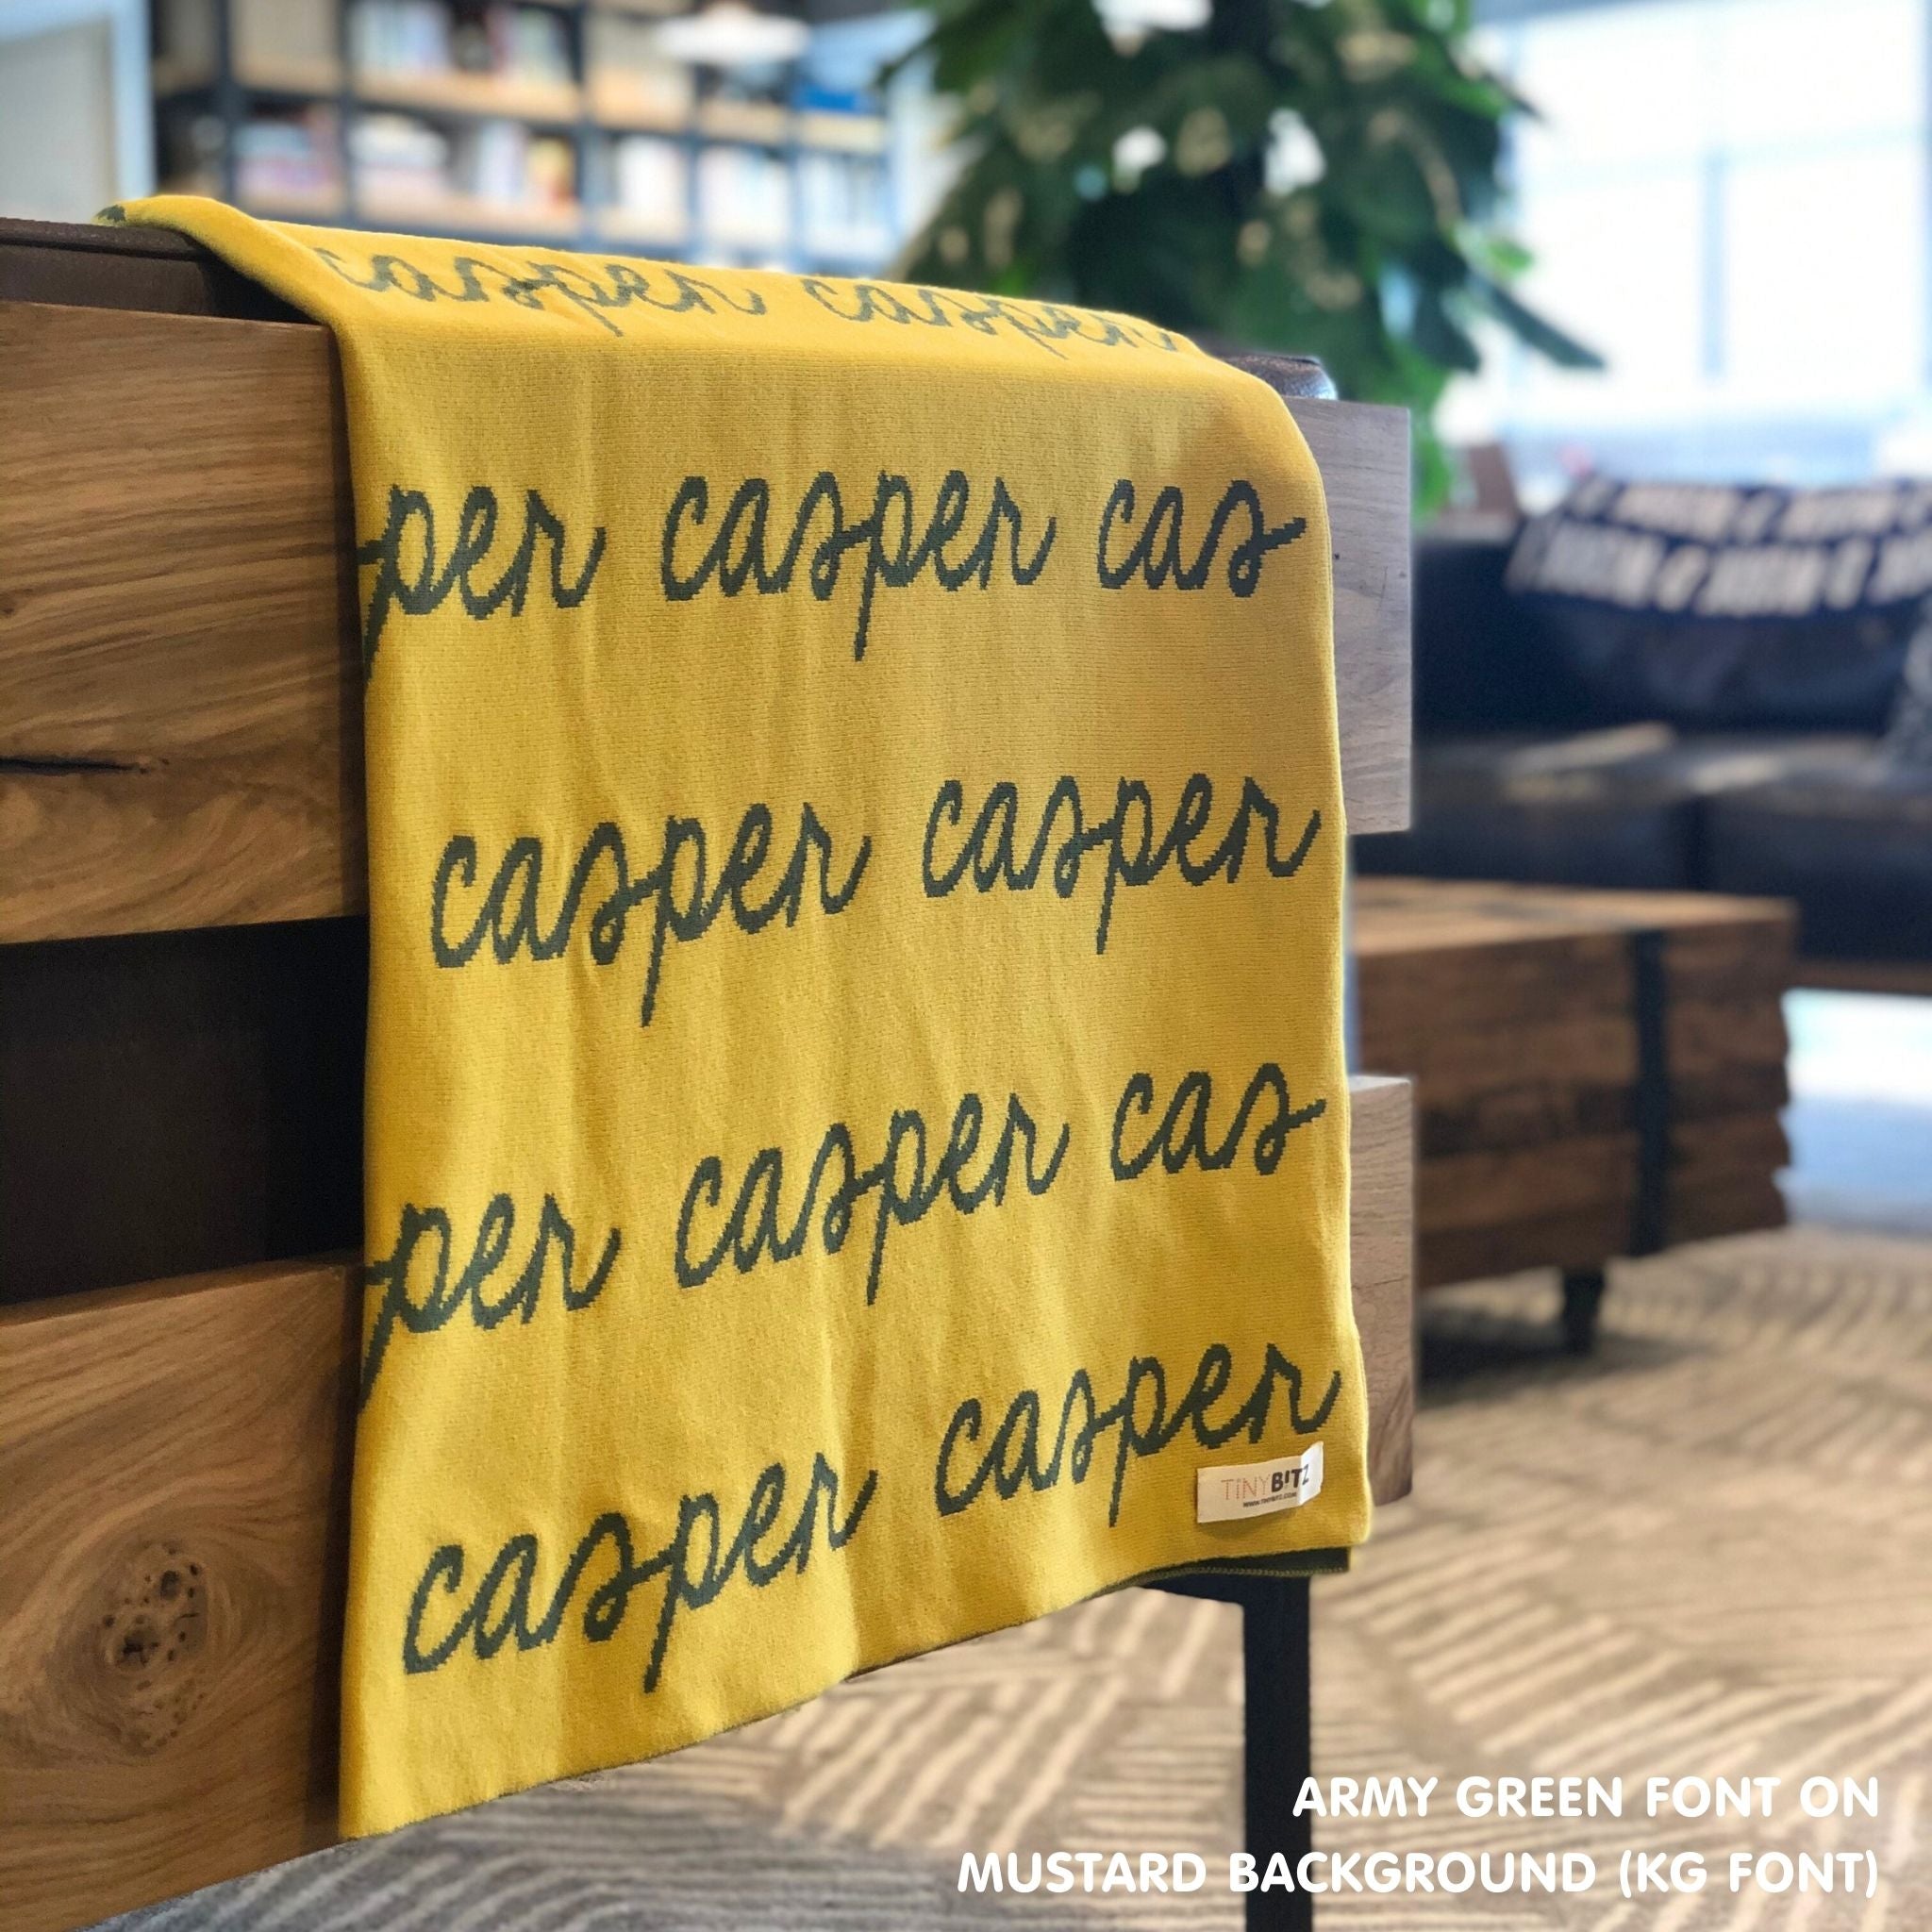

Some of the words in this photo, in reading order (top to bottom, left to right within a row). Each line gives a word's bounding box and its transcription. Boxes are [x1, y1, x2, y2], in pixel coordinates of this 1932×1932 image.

[313, 248, 766, 337] casper
[801, 277, 1178, 360] casper
[662, 471, 1057, 660] casper
[1098, 479, 1307, 598] cas
[432, 803, 872, 1024] casper
[924, 774, 1322, 953] casper
[675, 1093, 1069, 1303] casper
[1111, 1063, 1325, 1179] cas
[404, 1455, 877, 1692] casper
[937, 1343, 1341, 1527] casper
